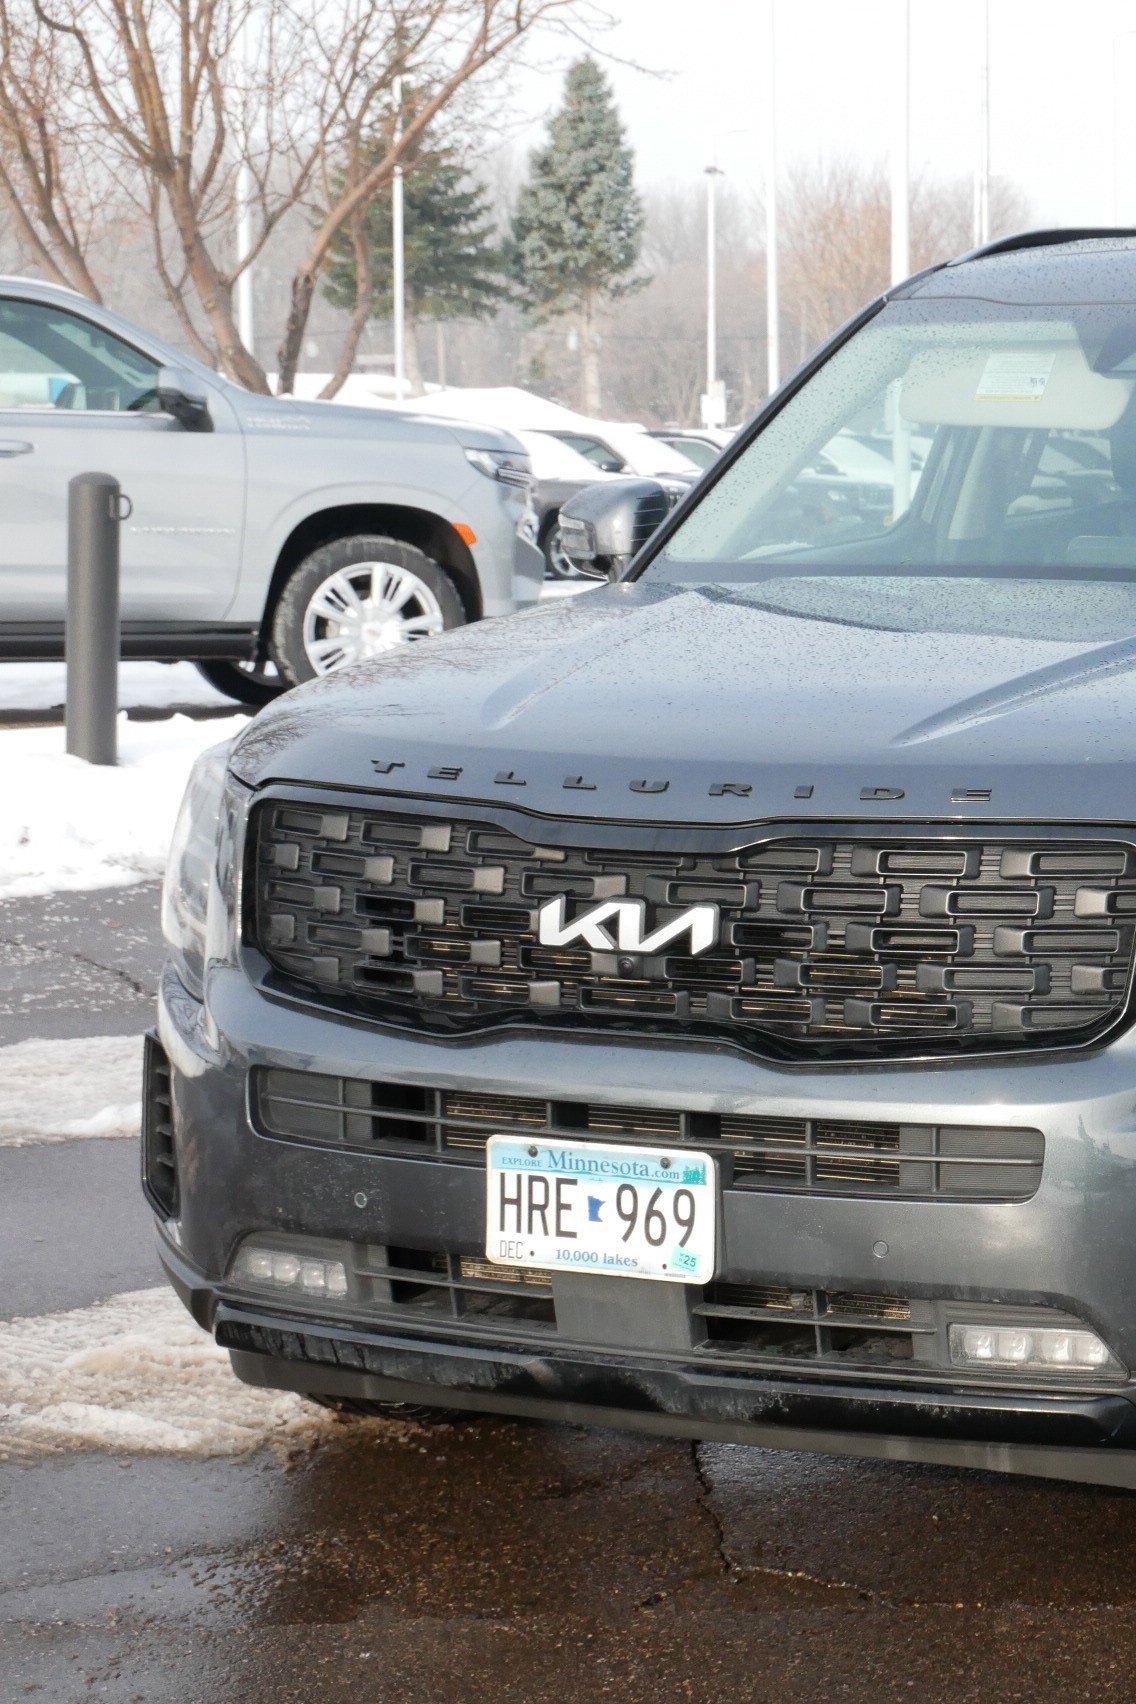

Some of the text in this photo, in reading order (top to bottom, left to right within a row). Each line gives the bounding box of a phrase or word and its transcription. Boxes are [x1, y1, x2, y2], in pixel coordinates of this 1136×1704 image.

[371, 759, 993, 803] TELLURIDE
[538, 893, 720, 956] KIA
[502, 1156, 542, 1168] EXPLORE
[499, 1172, 696, 1249] HRE 969
[499, 1240, 524, 1260] DEC
[555, 1249, 639, 1268] 10,000 lakes
[683, 1255, 697, 1268] 25
